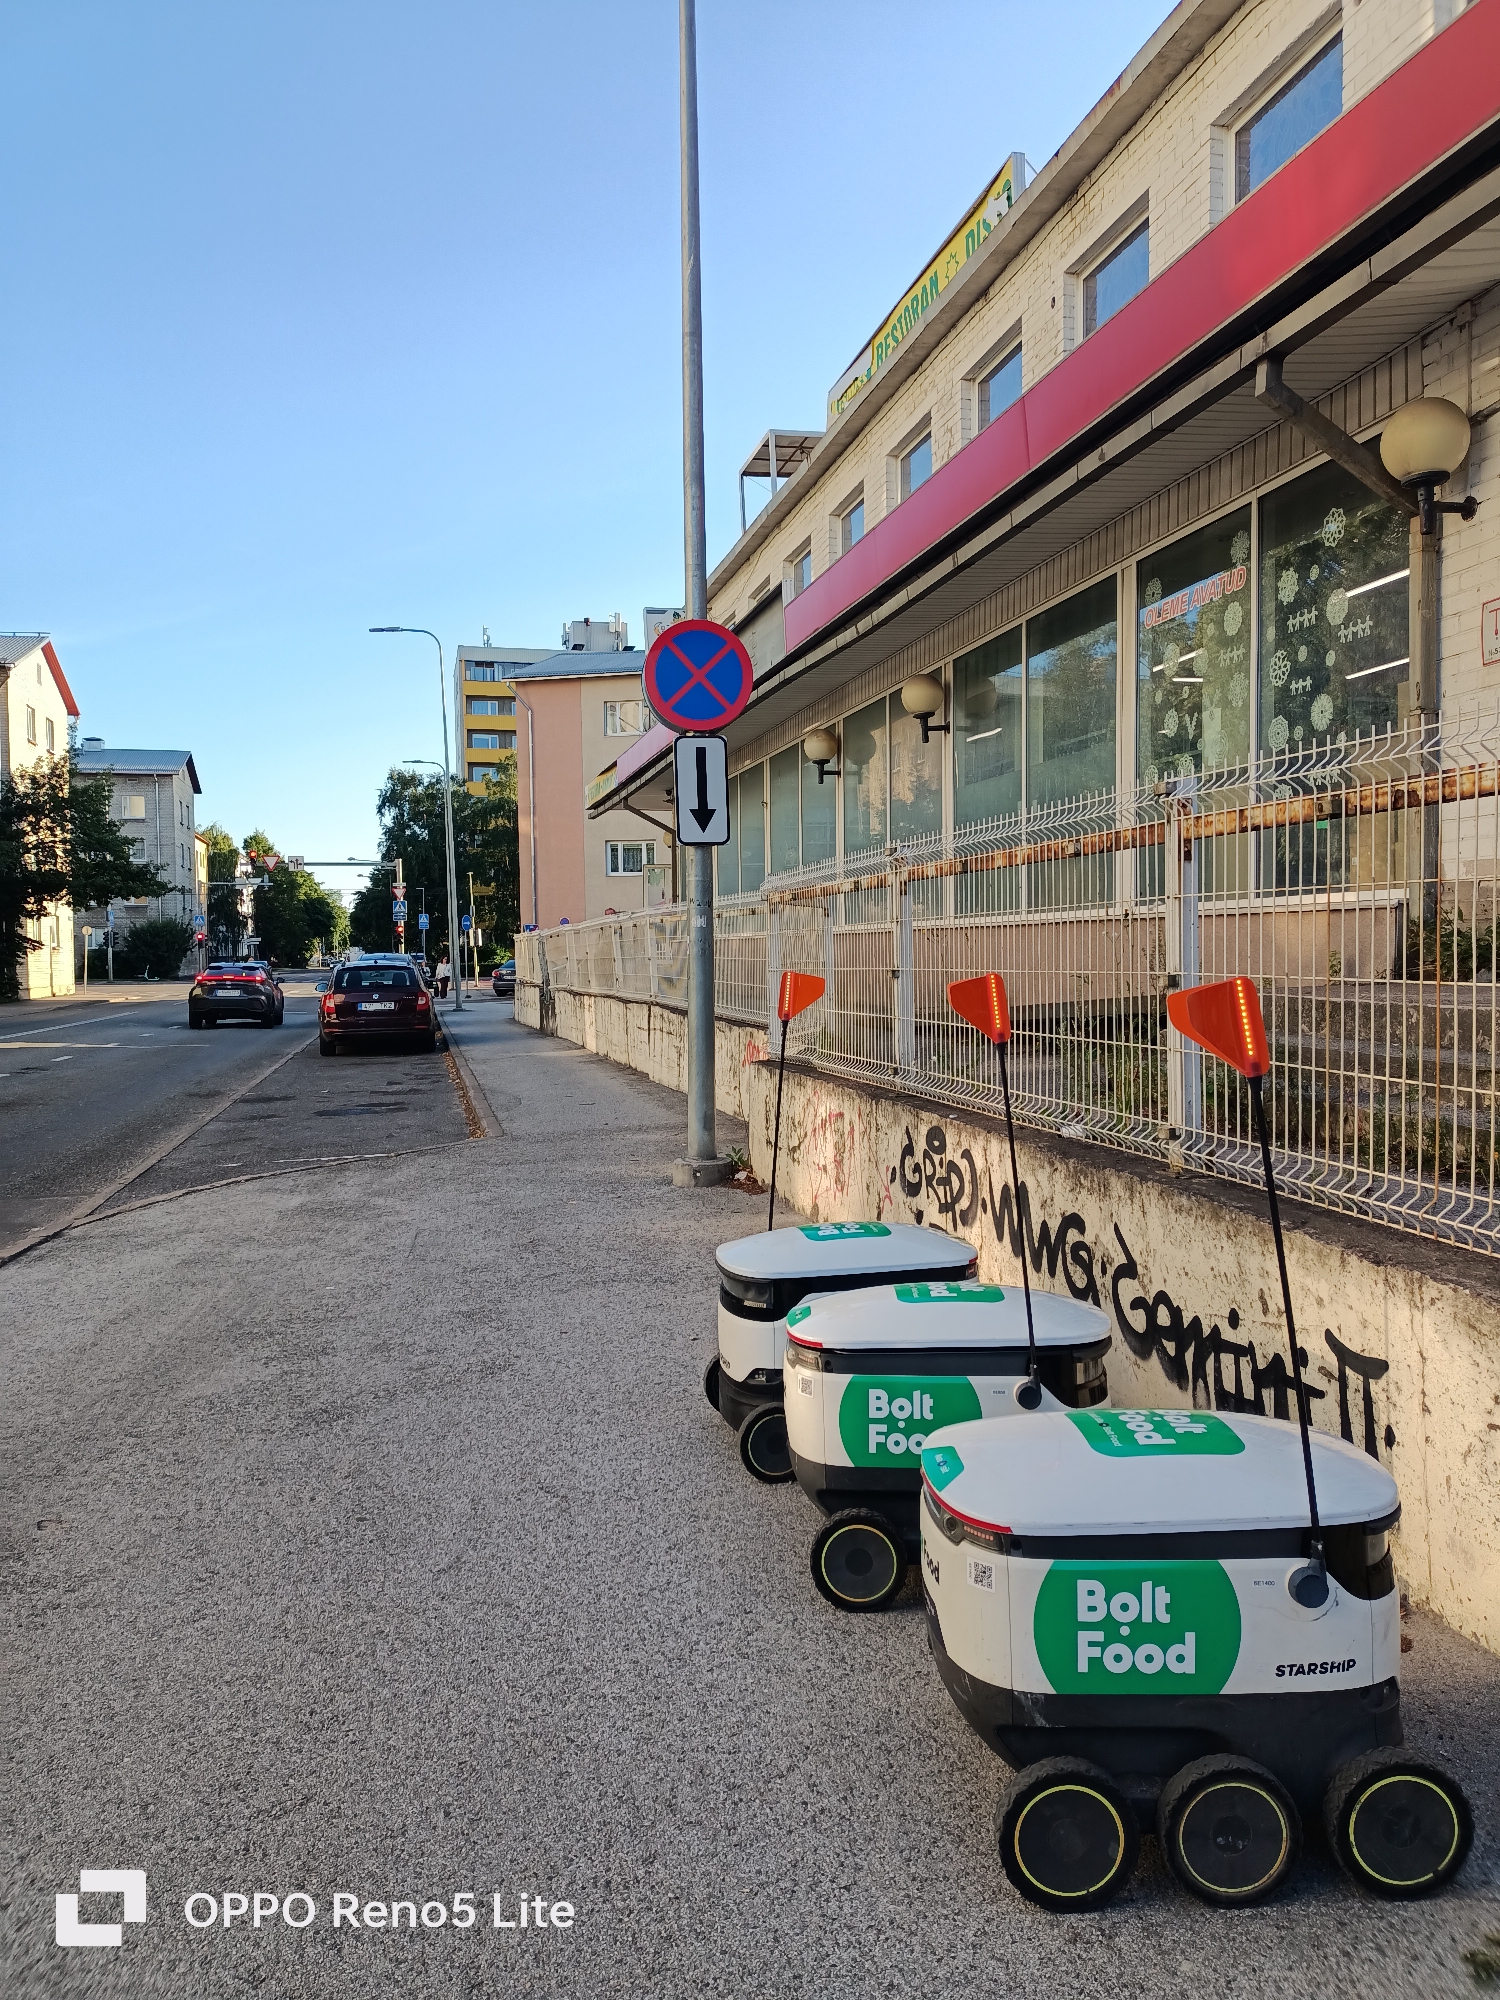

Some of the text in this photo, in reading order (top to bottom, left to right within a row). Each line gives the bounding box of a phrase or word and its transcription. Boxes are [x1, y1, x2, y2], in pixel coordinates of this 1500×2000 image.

[1144, 566, 1246, 629] OLEME AVATUD
[868, 1389, 934, 1421] Bolt
[868, 1424, 927, 1455] Foo
[1077, 1579, 1171, 1623] Bolt
[1077, 1630, 1196, 1674] Food
[1275, 1658, 1357, 1678] STARSHIP
